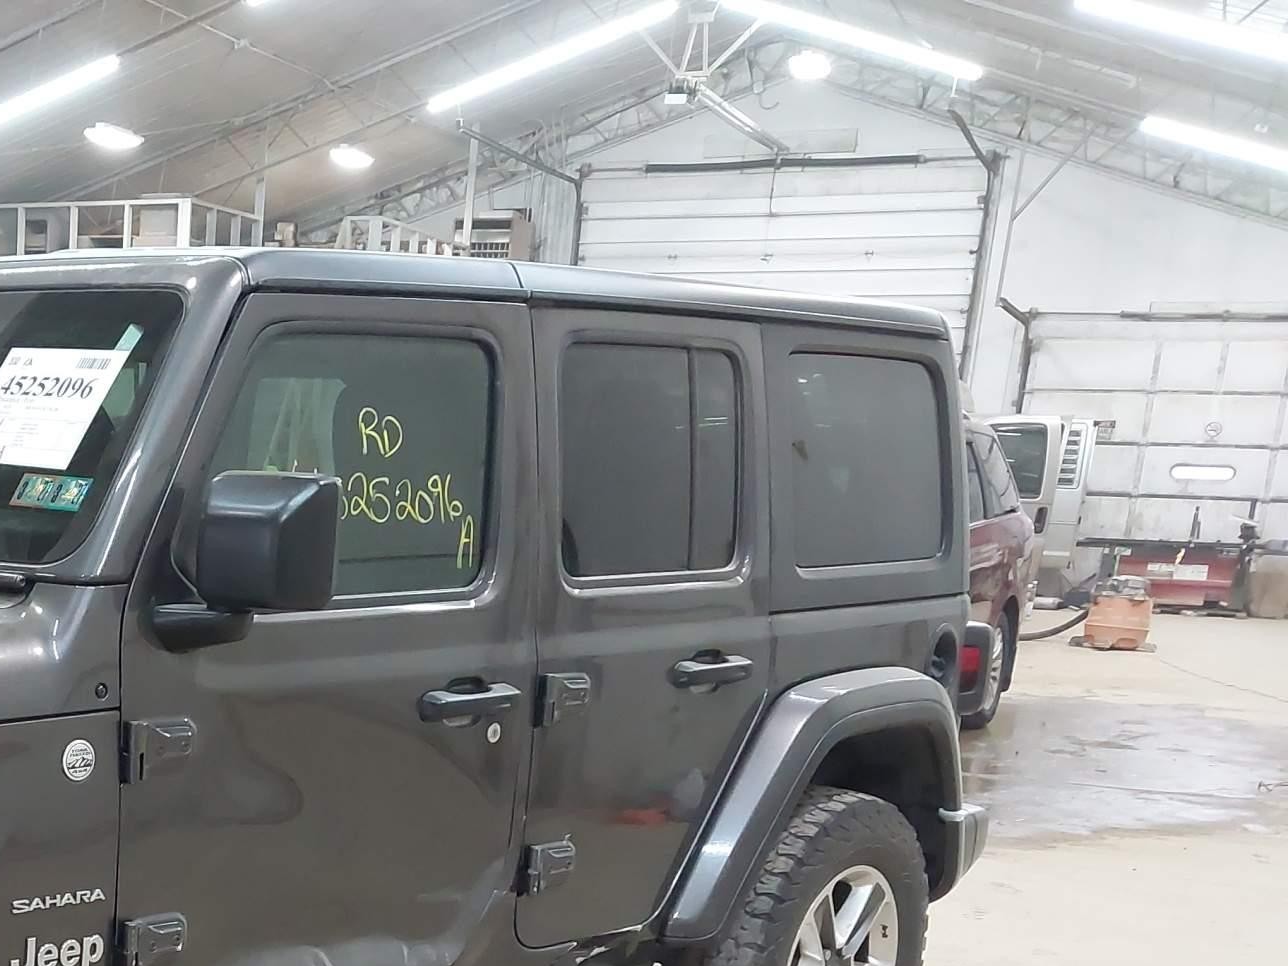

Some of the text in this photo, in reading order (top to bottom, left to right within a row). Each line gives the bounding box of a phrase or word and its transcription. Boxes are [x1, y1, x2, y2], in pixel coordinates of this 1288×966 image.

[0, 375, 99, 399] 45252096
[359, 407, 403, 458] RD
[11, 888, 106, 914] SAHARA
